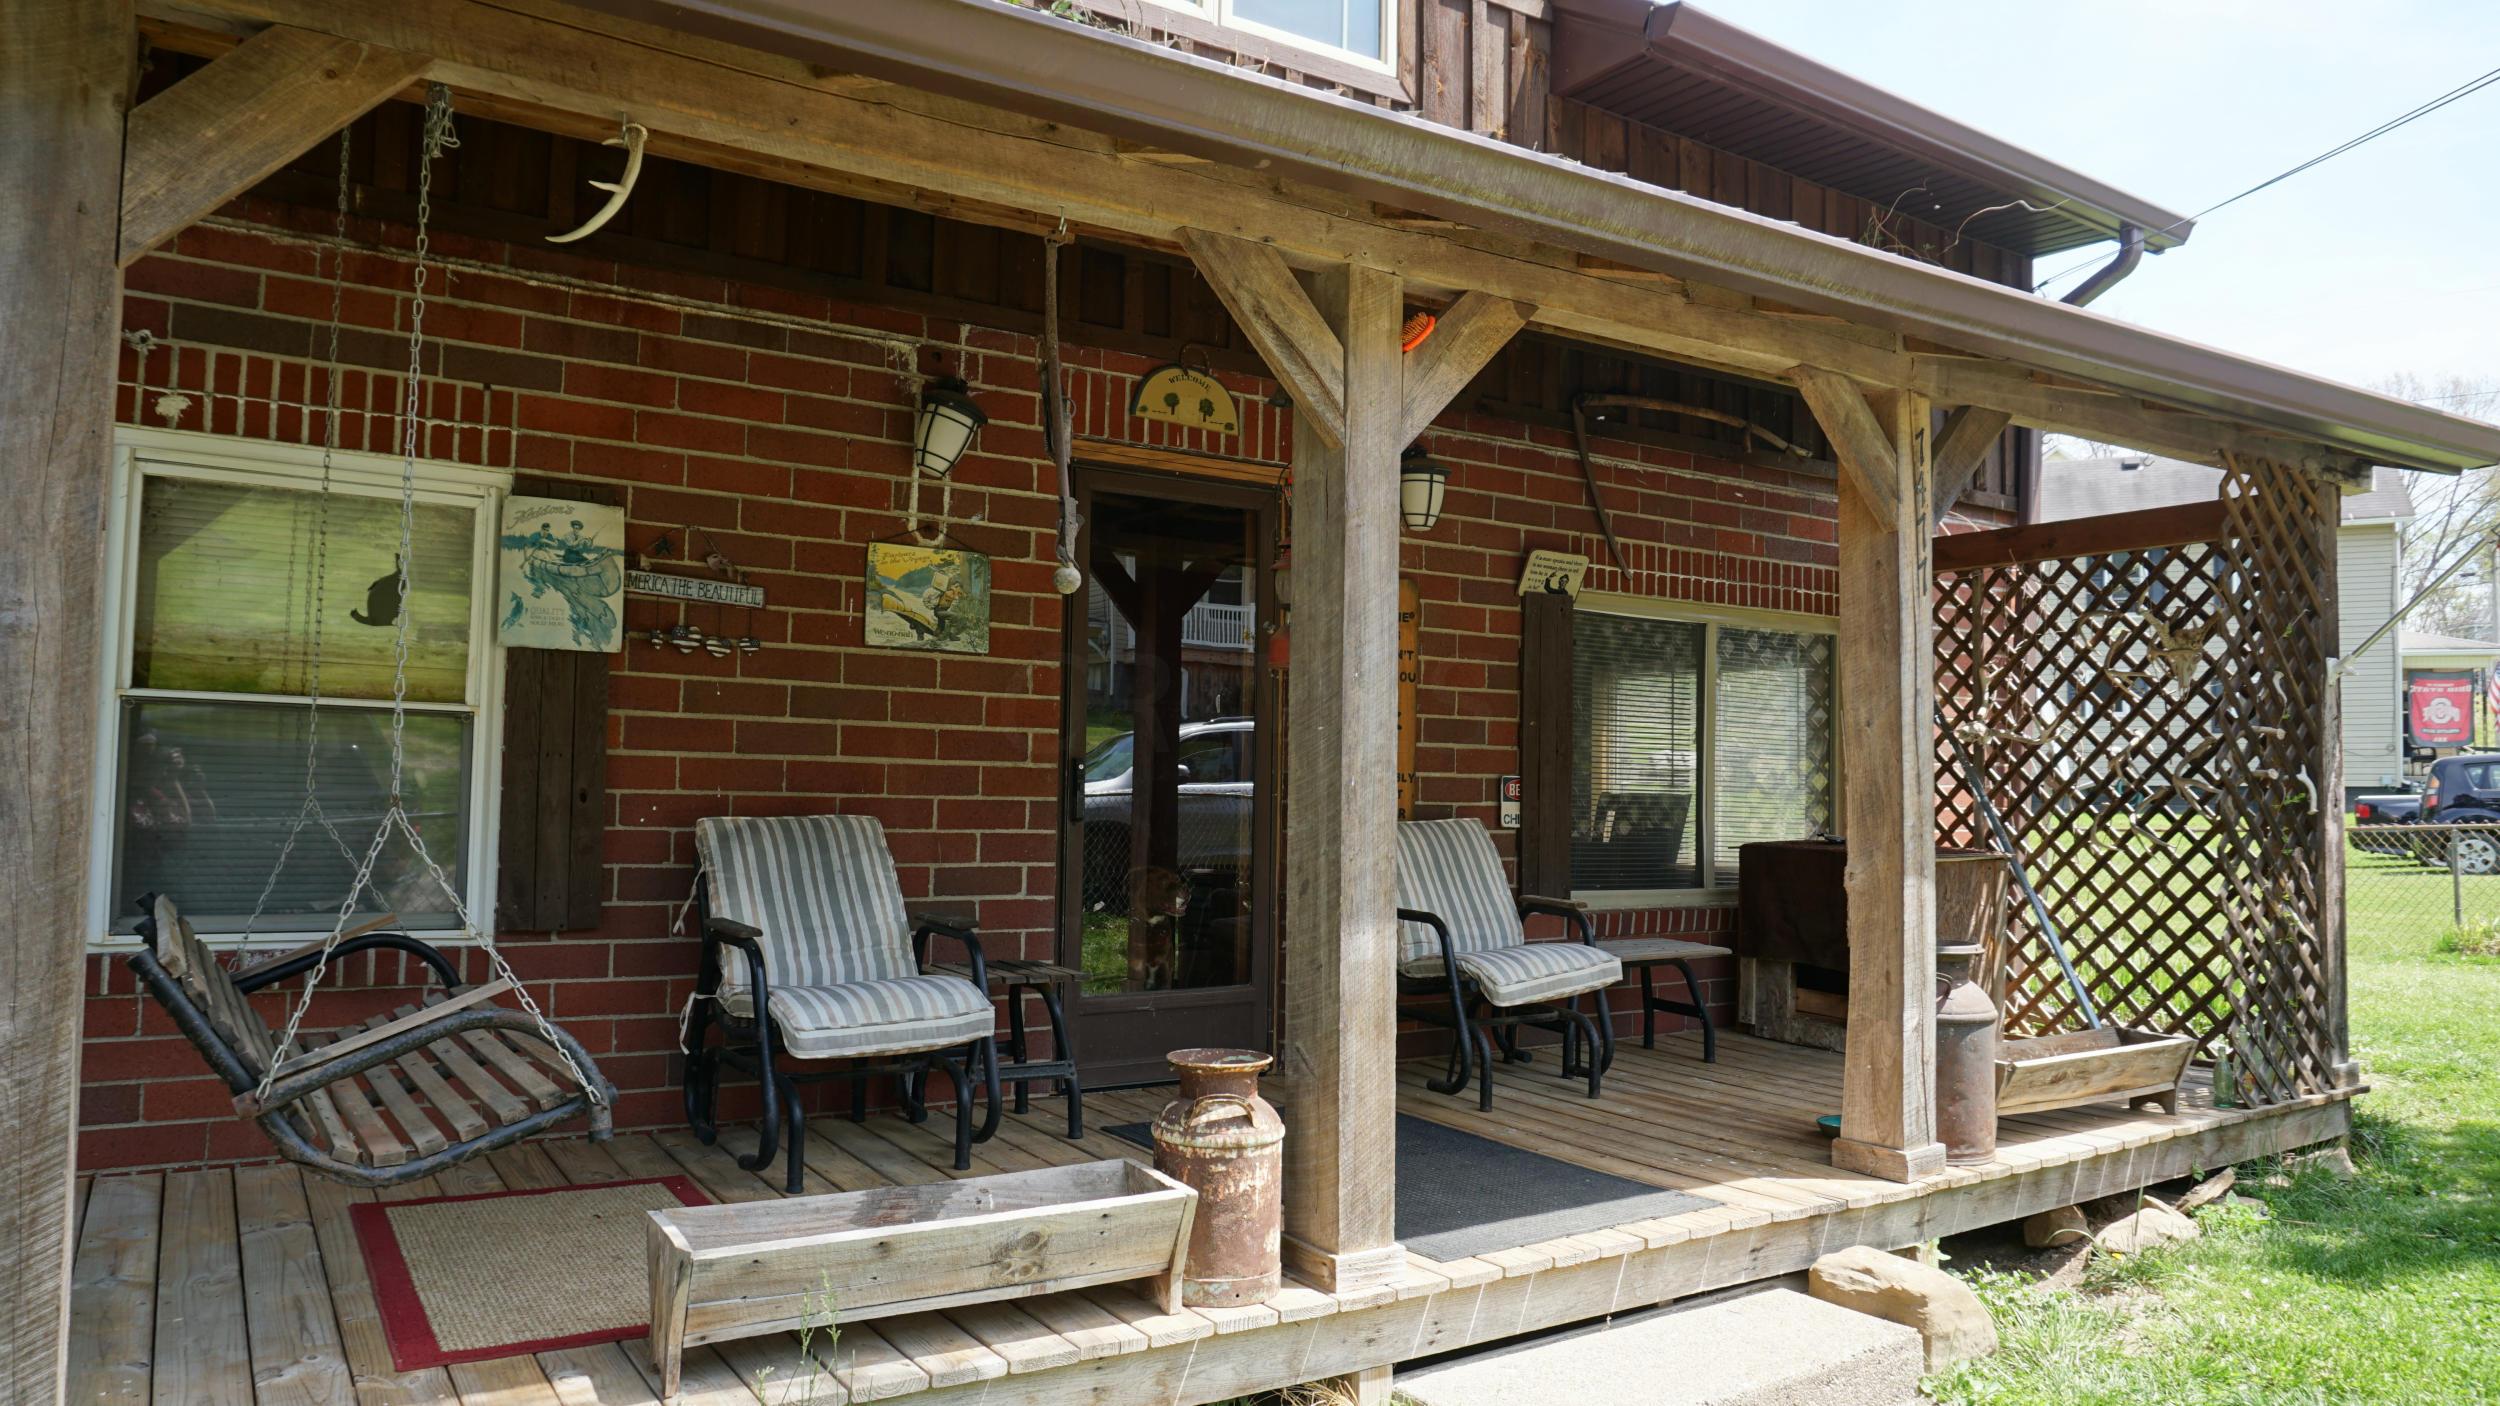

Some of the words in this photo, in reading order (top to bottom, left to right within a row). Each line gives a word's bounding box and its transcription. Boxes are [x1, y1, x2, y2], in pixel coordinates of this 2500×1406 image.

[1168, 374, 1212, 392] WELCOME
[626, 572, 670, 594] MERICA
[672, 577, 693, 597] THE
[697, 581, 761, 606] BEAUTIFUL
